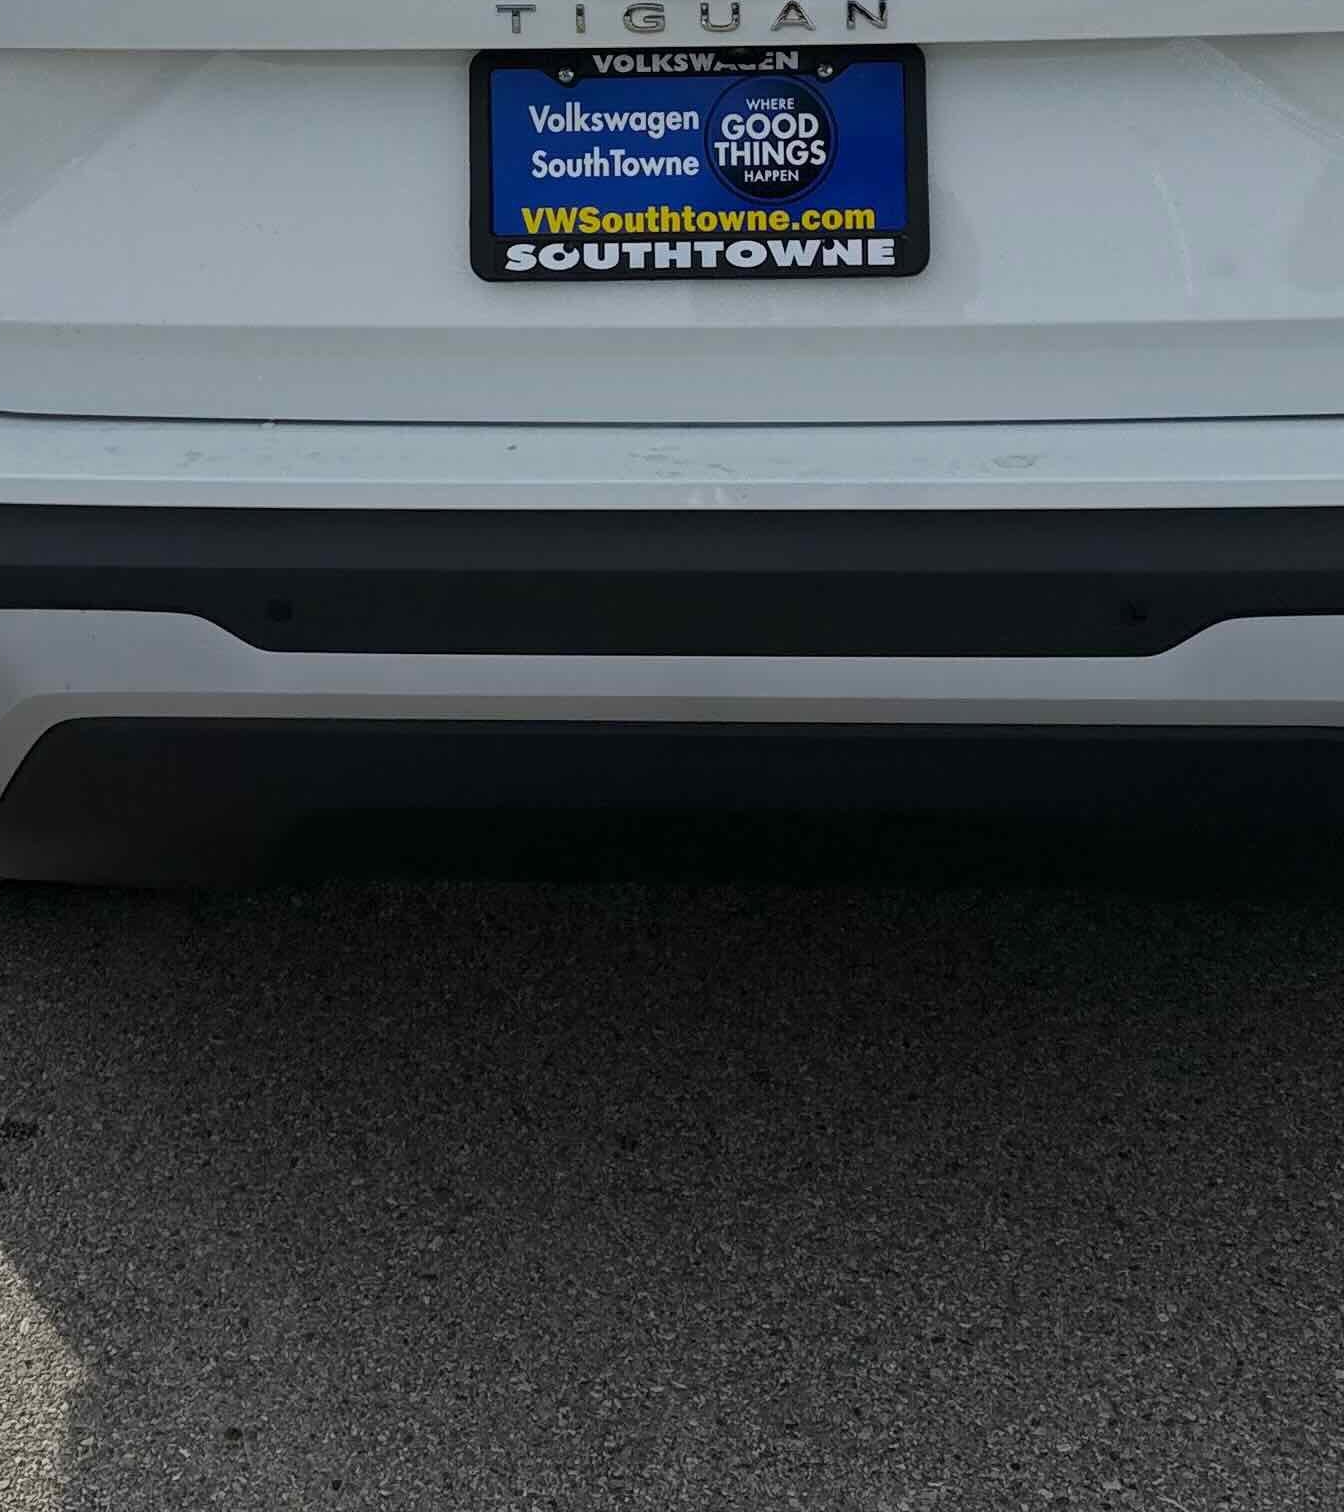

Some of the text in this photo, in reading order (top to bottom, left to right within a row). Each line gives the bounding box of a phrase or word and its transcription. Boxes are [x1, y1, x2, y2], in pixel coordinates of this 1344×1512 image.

[495, 0, 889, 34] TIGUAN
[746, 97, 796, 111] WHERE
[528, 103, 700, 140] Volkswagen
[720, 113, 820, 140] GOOD
[531, 146, 700, 178] SouthTowne
[714, 140, 827, 167] THINGS
[744, 168, 800, 183] HAPPEN
[521, 206, 876, 235] VWSouthtowne.com
[504, 239, 896, 273] SOUTHTOWNE
